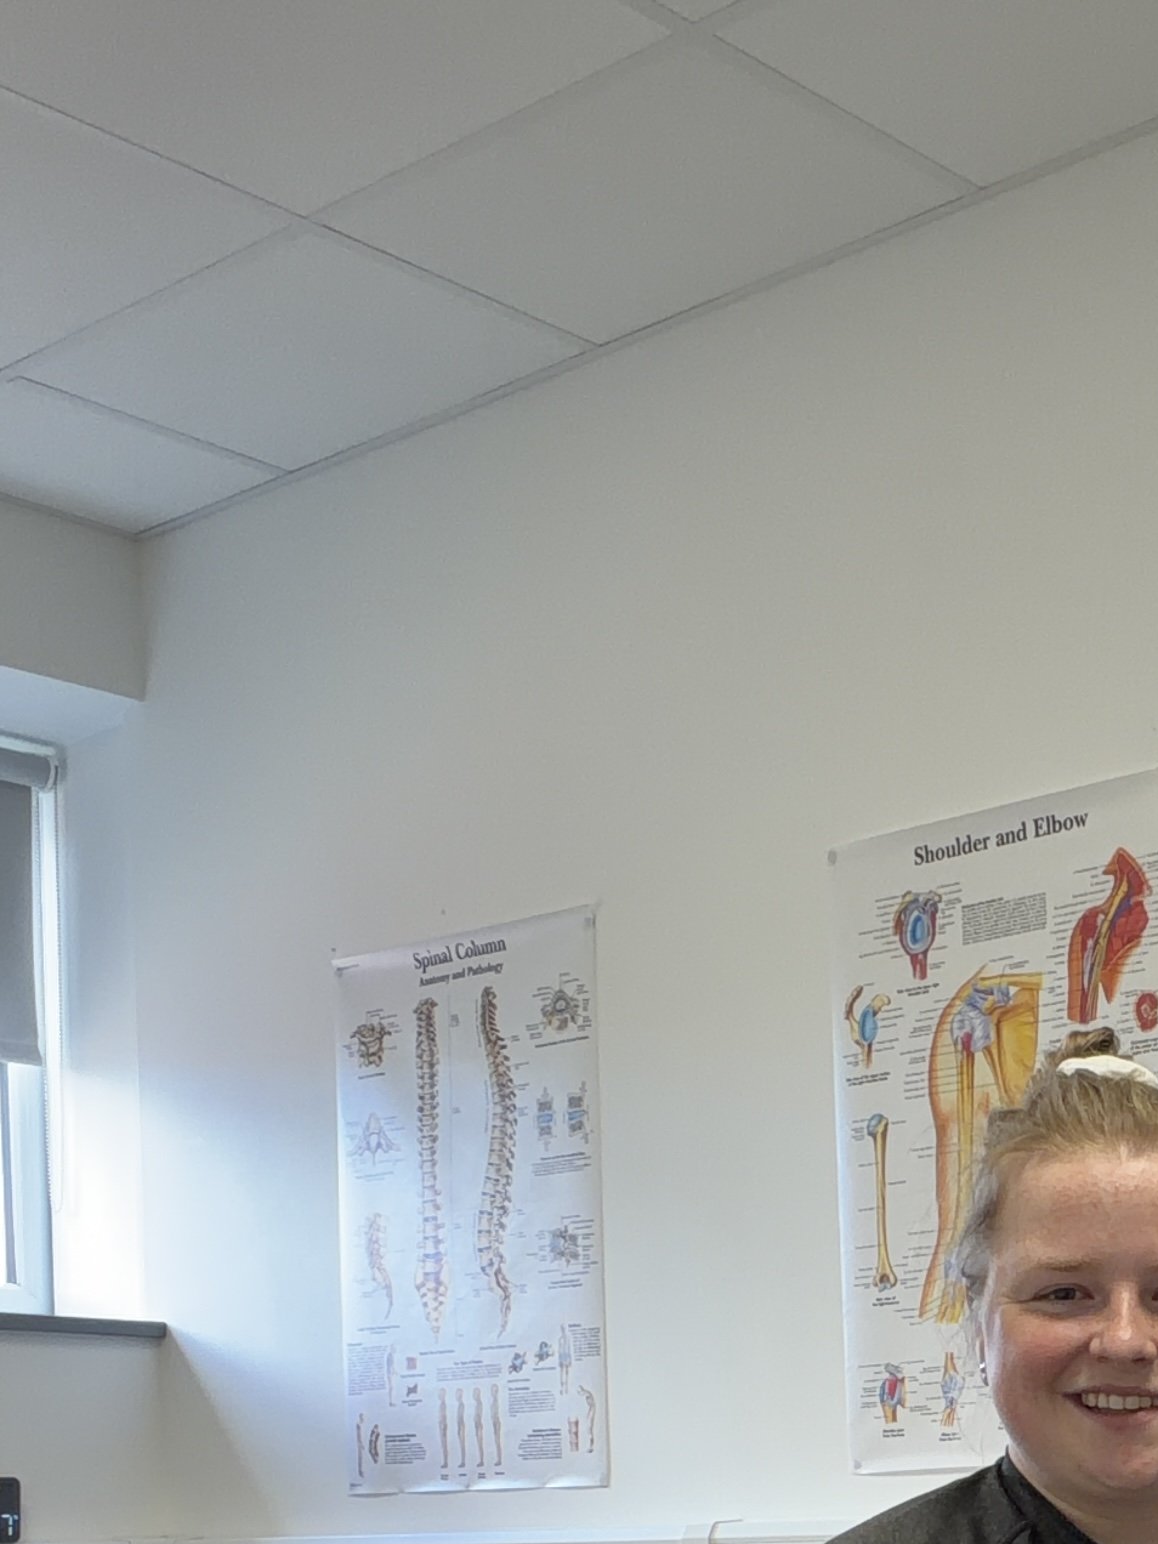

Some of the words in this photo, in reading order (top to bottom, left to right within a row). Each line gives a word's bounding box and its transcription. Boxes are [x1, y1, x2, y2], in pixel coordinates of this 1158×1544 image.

[914, 833, 991, 866] Shoulder
[996, 821, 1028, 847] and
[1033, 813, 1089, 839] Elbow
[413, 945, 453, 974] Spinal
[455, 939, 507, 960] Column
[419, 974, 450, 987] Anatomy
[452, 967, 466, 980] and
[467, 962, 504, 976] Pathology
